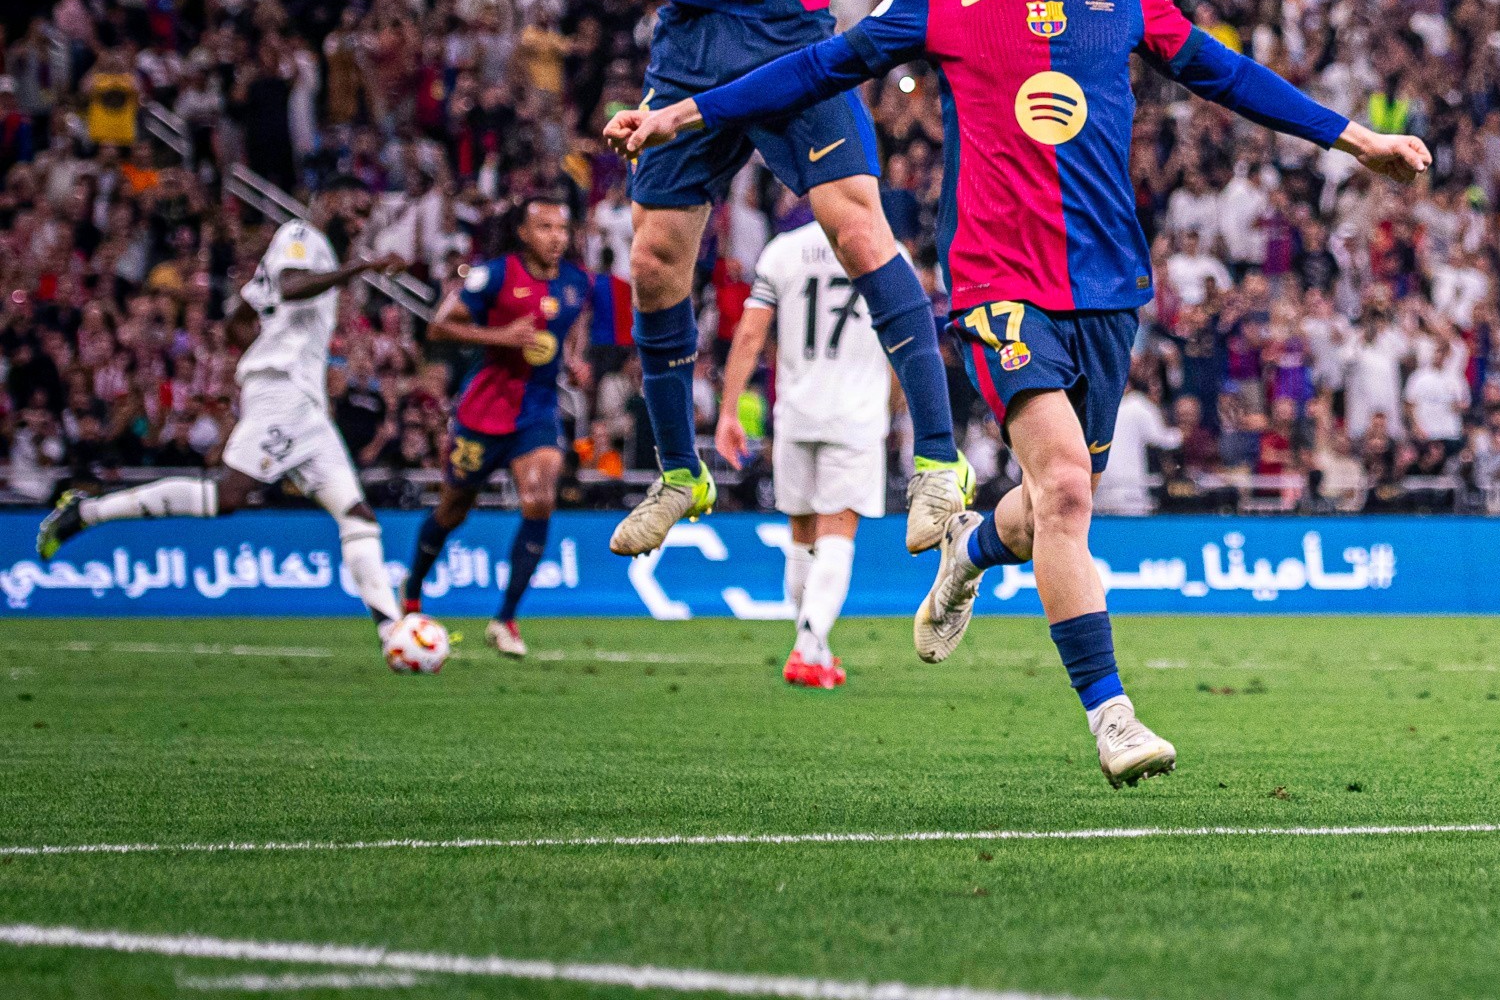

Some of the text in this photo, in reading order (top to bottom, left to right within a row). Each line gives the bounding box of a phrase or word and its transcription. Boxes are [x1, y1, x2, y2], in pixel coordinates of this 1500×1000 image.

[802, 275, 861, 360] 17
[964, 300, 1025, 352] 17
[0, 547, 187, 610] الراجحي
